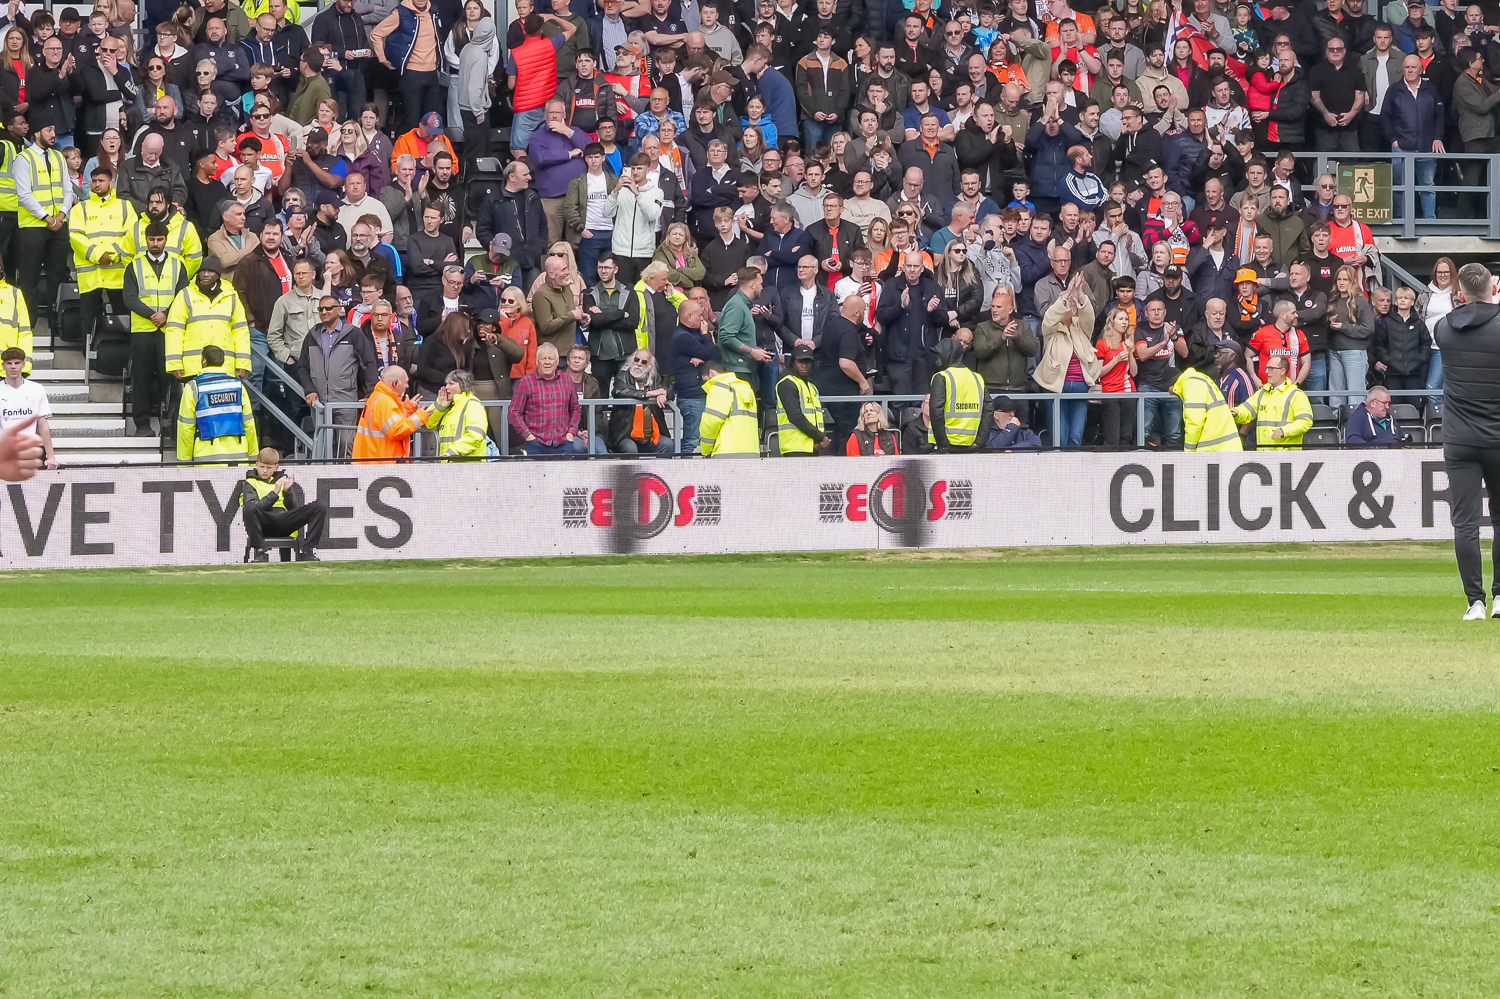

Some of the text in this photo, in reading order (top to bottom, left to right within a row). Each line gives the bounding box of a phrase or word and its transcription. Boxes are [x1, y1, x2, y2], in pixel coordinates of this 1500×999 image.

[1350, 208, 1390, 219] RE EXIT
[1336, 245, 1356, 254] utilita
[1270, 348, 1290, 357] utilita
[210, 390, 238, 404] SECURITY
[956, 402, 980, 411] SECURITY
[2, 407, 33, 417] FanHub
[1109, 460, 1327, 532] CLICK
[1347, 460, 1396, 529] &
[0, 475, 414, 558] VE TYES
